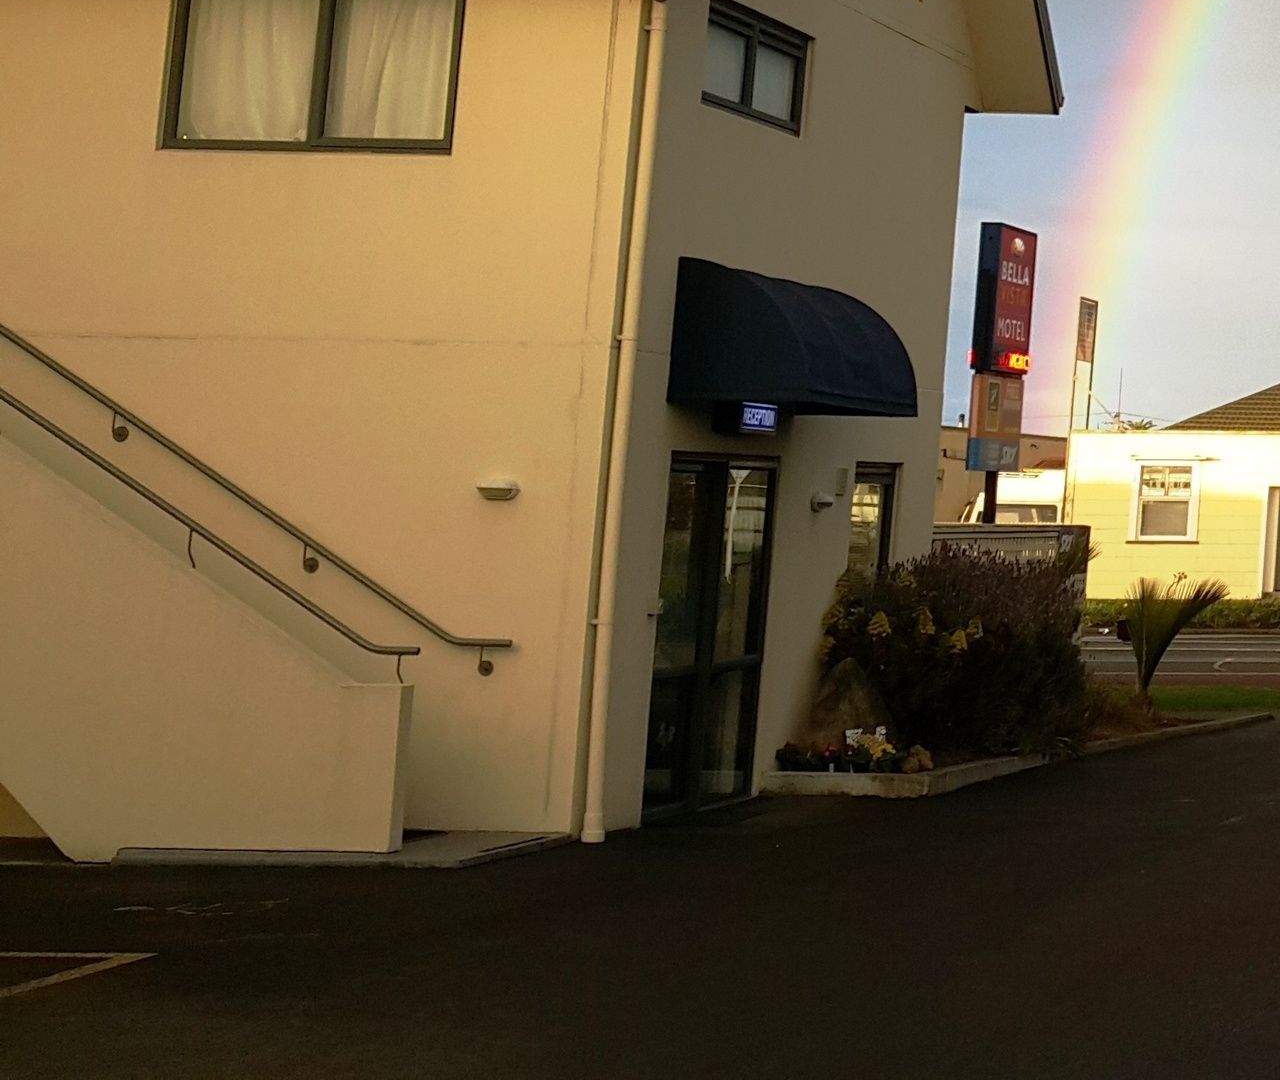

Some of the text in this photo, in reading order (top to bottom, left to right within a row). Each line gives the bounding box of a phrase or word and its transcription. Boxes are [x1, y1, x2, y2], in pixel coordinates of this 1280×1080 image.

[1001, 261, 1029, 286] BELLA
[996, 317, 1025, 341] MOTEL
[743, 407, 775, 426] RECEPTION
